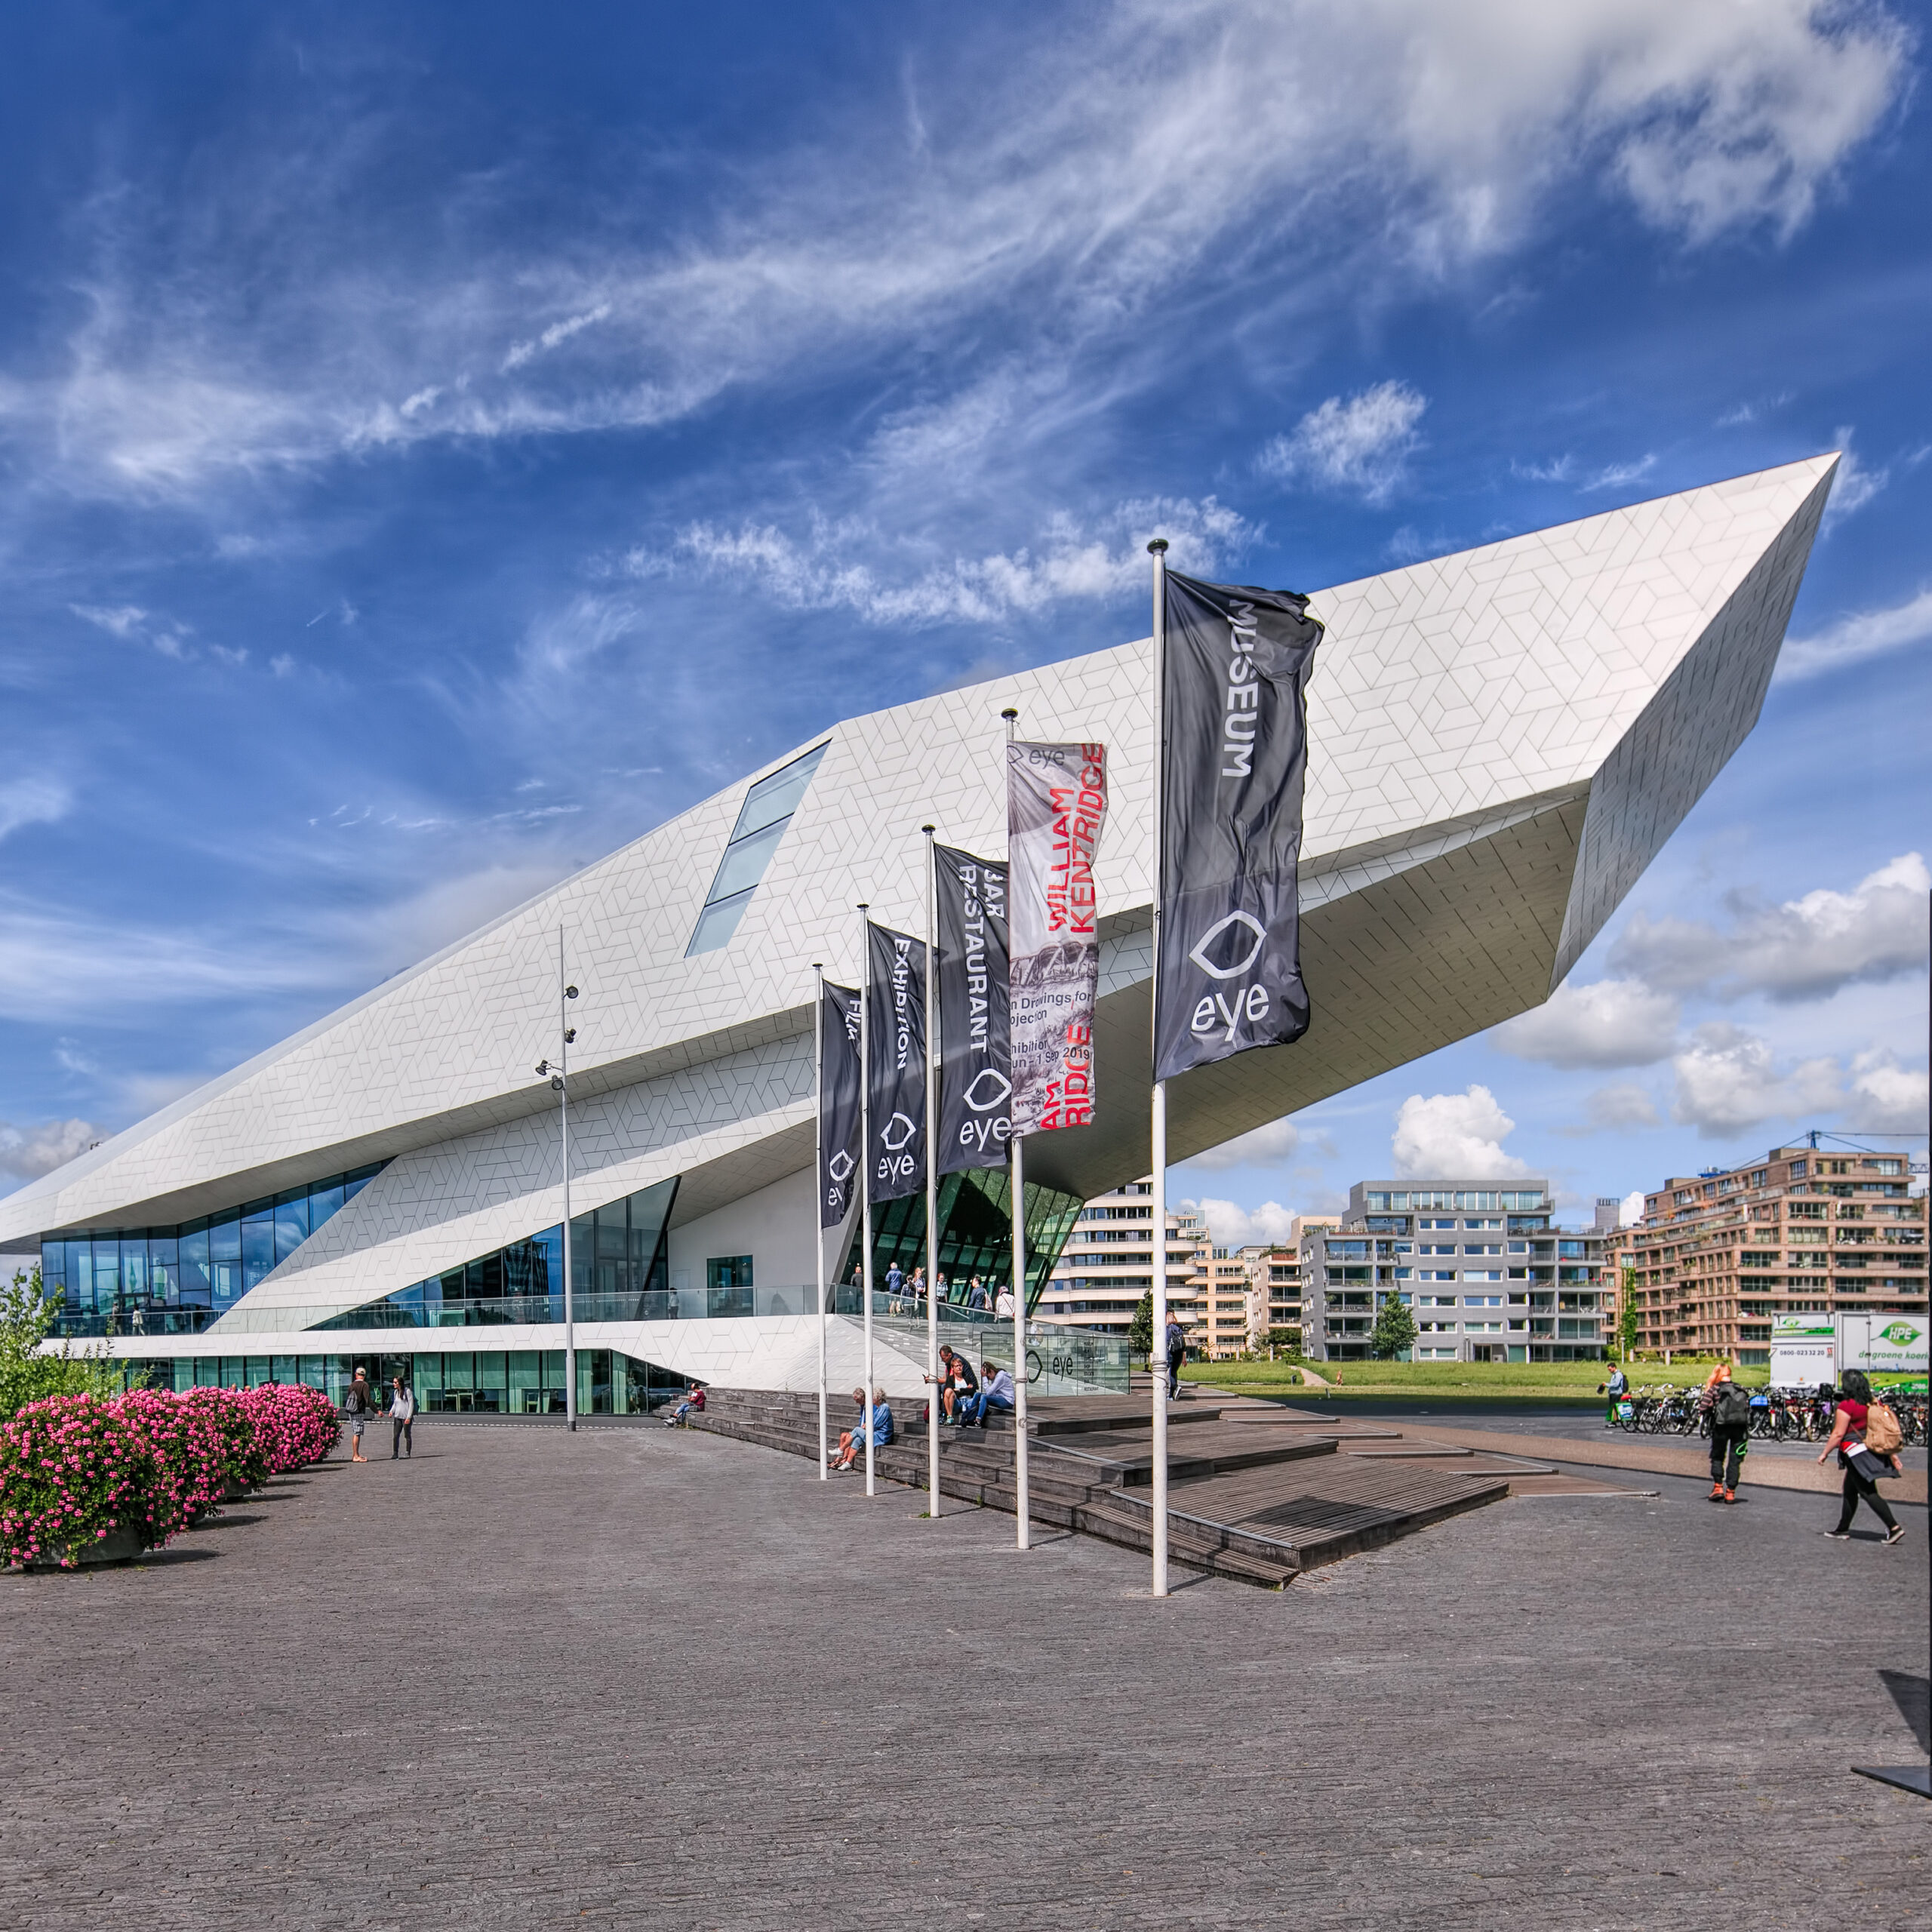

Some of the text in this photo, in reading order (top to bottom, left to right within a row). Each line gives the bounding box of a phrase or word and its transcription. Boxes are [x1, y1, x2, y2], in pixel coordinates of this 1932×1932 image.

[1222, 598, 1259, 777] MUSEUM
[1029, 749, 1065, 769] eye
[1070, 743, 1104, 933] KENTRIDGE
[1047, 788, 1075, 931] WILLIAM
[983, 869, 1004, 918] BAR
[958, 865, 989, 1053] RESTAURANT
[1021, 992, 1072, 1009] Drawings
[1075, 991, 1091, 1001] for
[1191, 983, 1269, 1041] eye
[1045, 1051, 1060, 1063] Sep
[1063, 1047, 1090, 1060] 2019
[959, 1116, 1011, 1152] eye
[878, 1155, 915, 1185] eye
[1888, 1327, 1912, 1340] HPE
[1053, 1356, 1073, 1381] eye
[1872, 1352, 1903, 1361] groene
